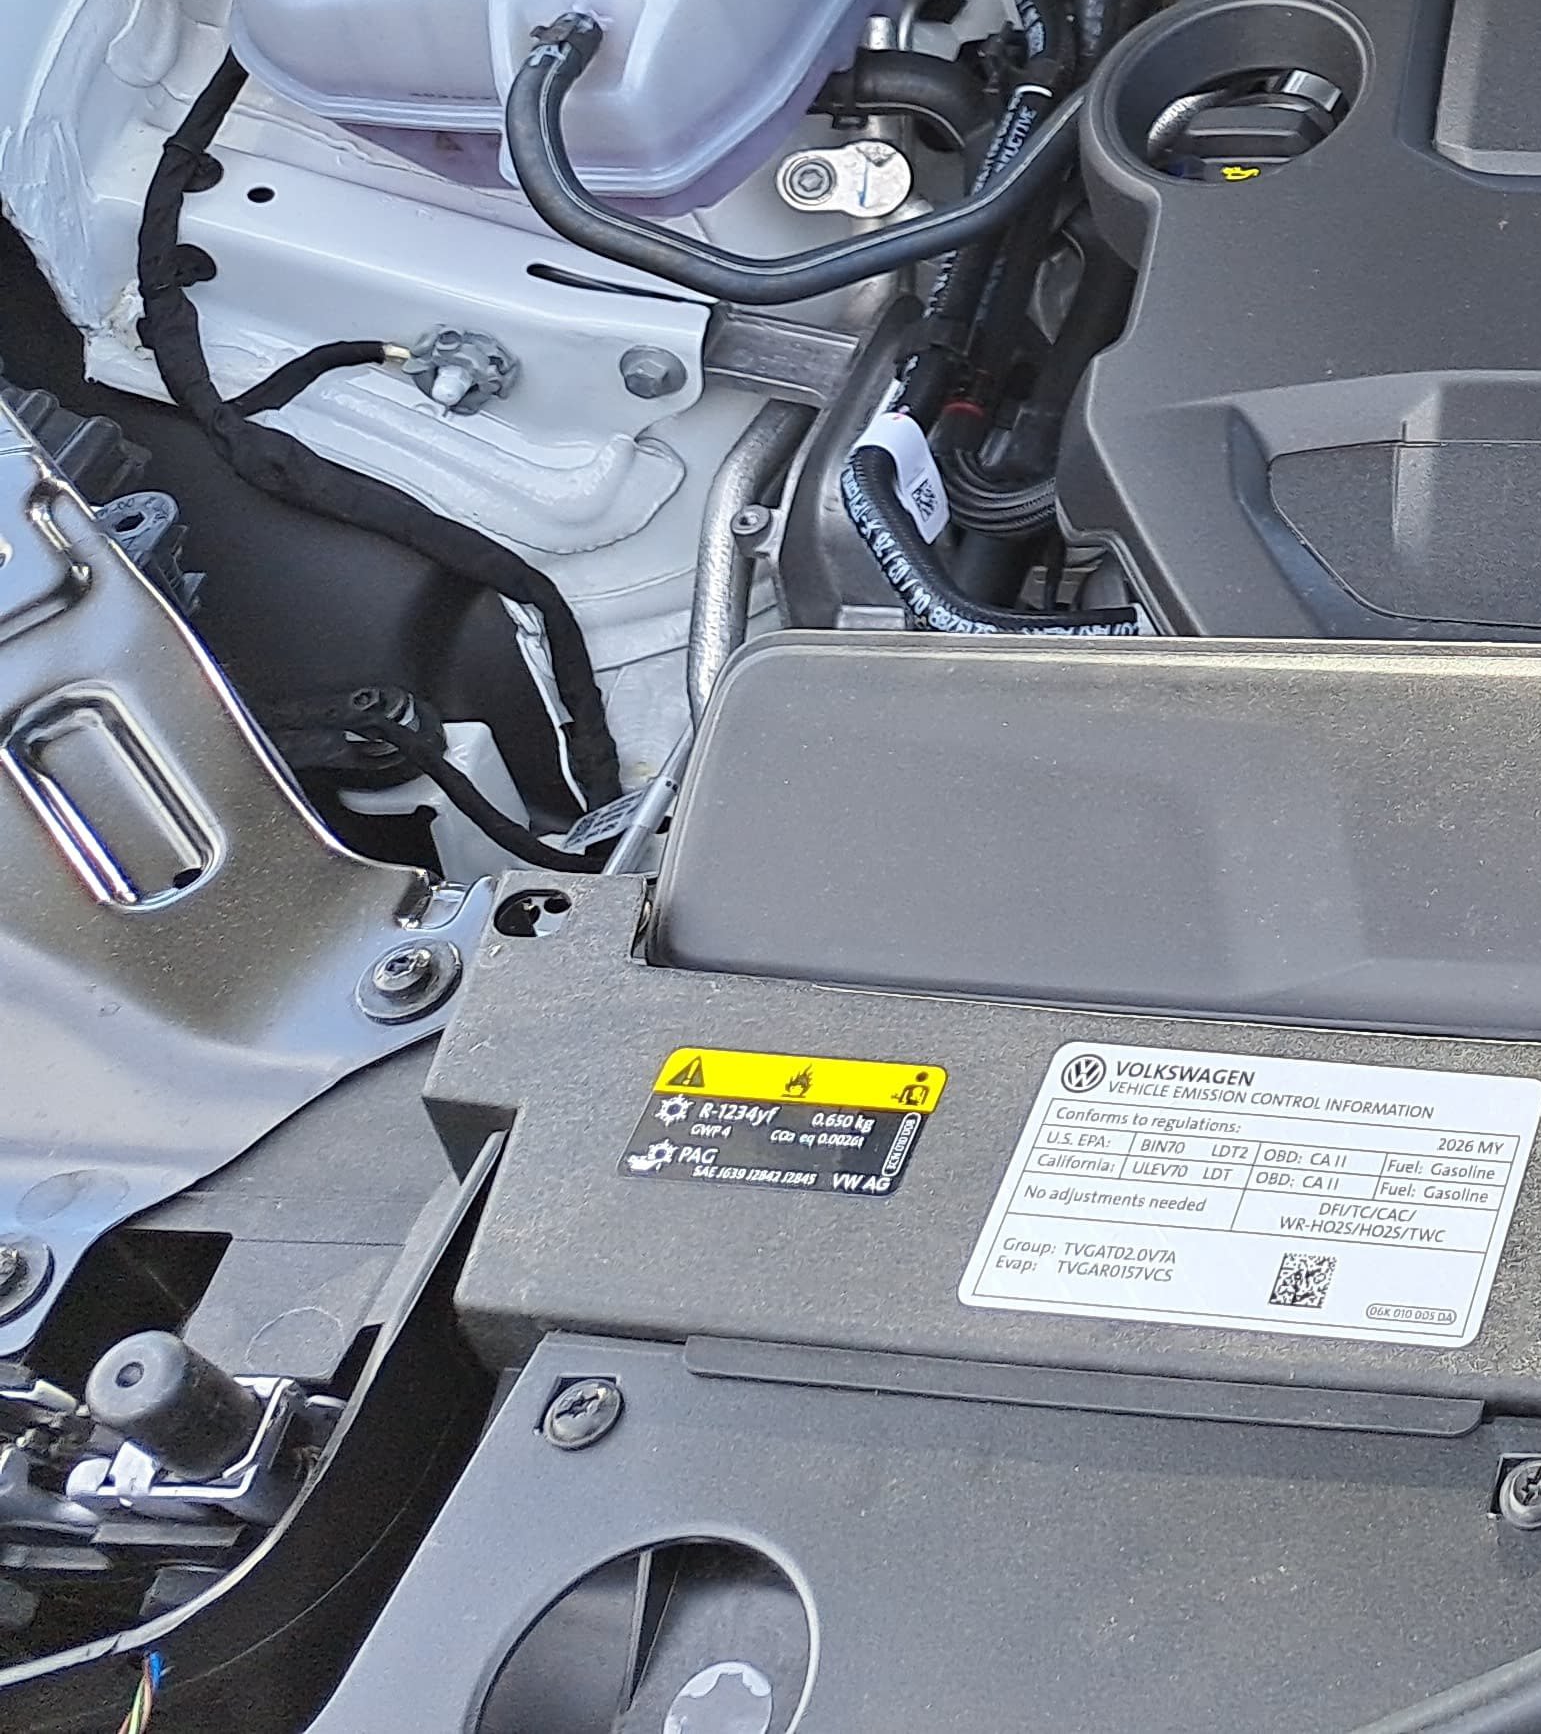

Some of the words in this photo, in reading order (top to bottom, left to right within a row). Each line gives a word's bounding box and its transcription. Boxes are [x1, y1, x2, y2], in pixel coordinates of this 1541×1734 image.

[1116, 1060, 1255, 1086] VOLKSWAGEN
[1108, 1080, 1170, 1097] VEHICLE
[1172, 1085, 1247, 1103] EMISSION
[1249, 1091, 1320, 1110] CONTROL
[1324, 1097, 1434, 1119] INFORMATION
[698, 1101, 780, 1126] R-1234yf
[811, 1112, 854, 1128] 0.650
[853, 1114, 875, 1133] kg
[1055, 1106, 1128, 1124] Conforms
[1131, 1112, 1148, 1126] to
[1150, 1115, 1241, 1133] regulations:
[1045, 1130, 1073, 1145] U.S.
[1076, 1132, 1111, 1148] EPA:
[1139, 1138, 1185, 1154] BIN70
[1210, 1143, 1249, 1159] LDT2
[1436, 1137, 1474, 1153] 2026
[1476, 1140, 1504, 1155] MY
[677, 1146, 718, 1163] PAG
[1036, 1153, 1115, 1173] California:
[1263, 1148, 1302, 1164] OBD:
[1309, 1152, 1330, 1166] CA
[692, 1164, 718, 1178] SAE
[1131, 1160, 1188, 1178] ULEV70
[1201, 1166, 1233, 1181] LDT
[1255, 1170, 1295, 1187] OBD:
[1301, 1175, 1323, 1189] CA
[1386, 1158, 1423, 1174] Fuel:
[1429, 1162, 1495, 1180] Gasoline
[832, 1172, 863, 1190] VW
[861, 1175, 890, 1191] AG
[1379, 1181, 1416, 1197] Fuel:
[1422, 1185, 1488, 1203] Gasoline
[1023, 1184, 1046, 1199] No
[1048, 1186, 1145, 1207] adjustments
[1147, 1195, 1207, 1212] needed
[1317, 1201, 1417, 1222] DFI/TC/CAC/
[1279, 1215, 1446, 1243] WR-HO2S/HO2S/TWC
[1002, 1236, 1056, 1257] Group:
[994, 1254, 1037, 1274] Evap:
